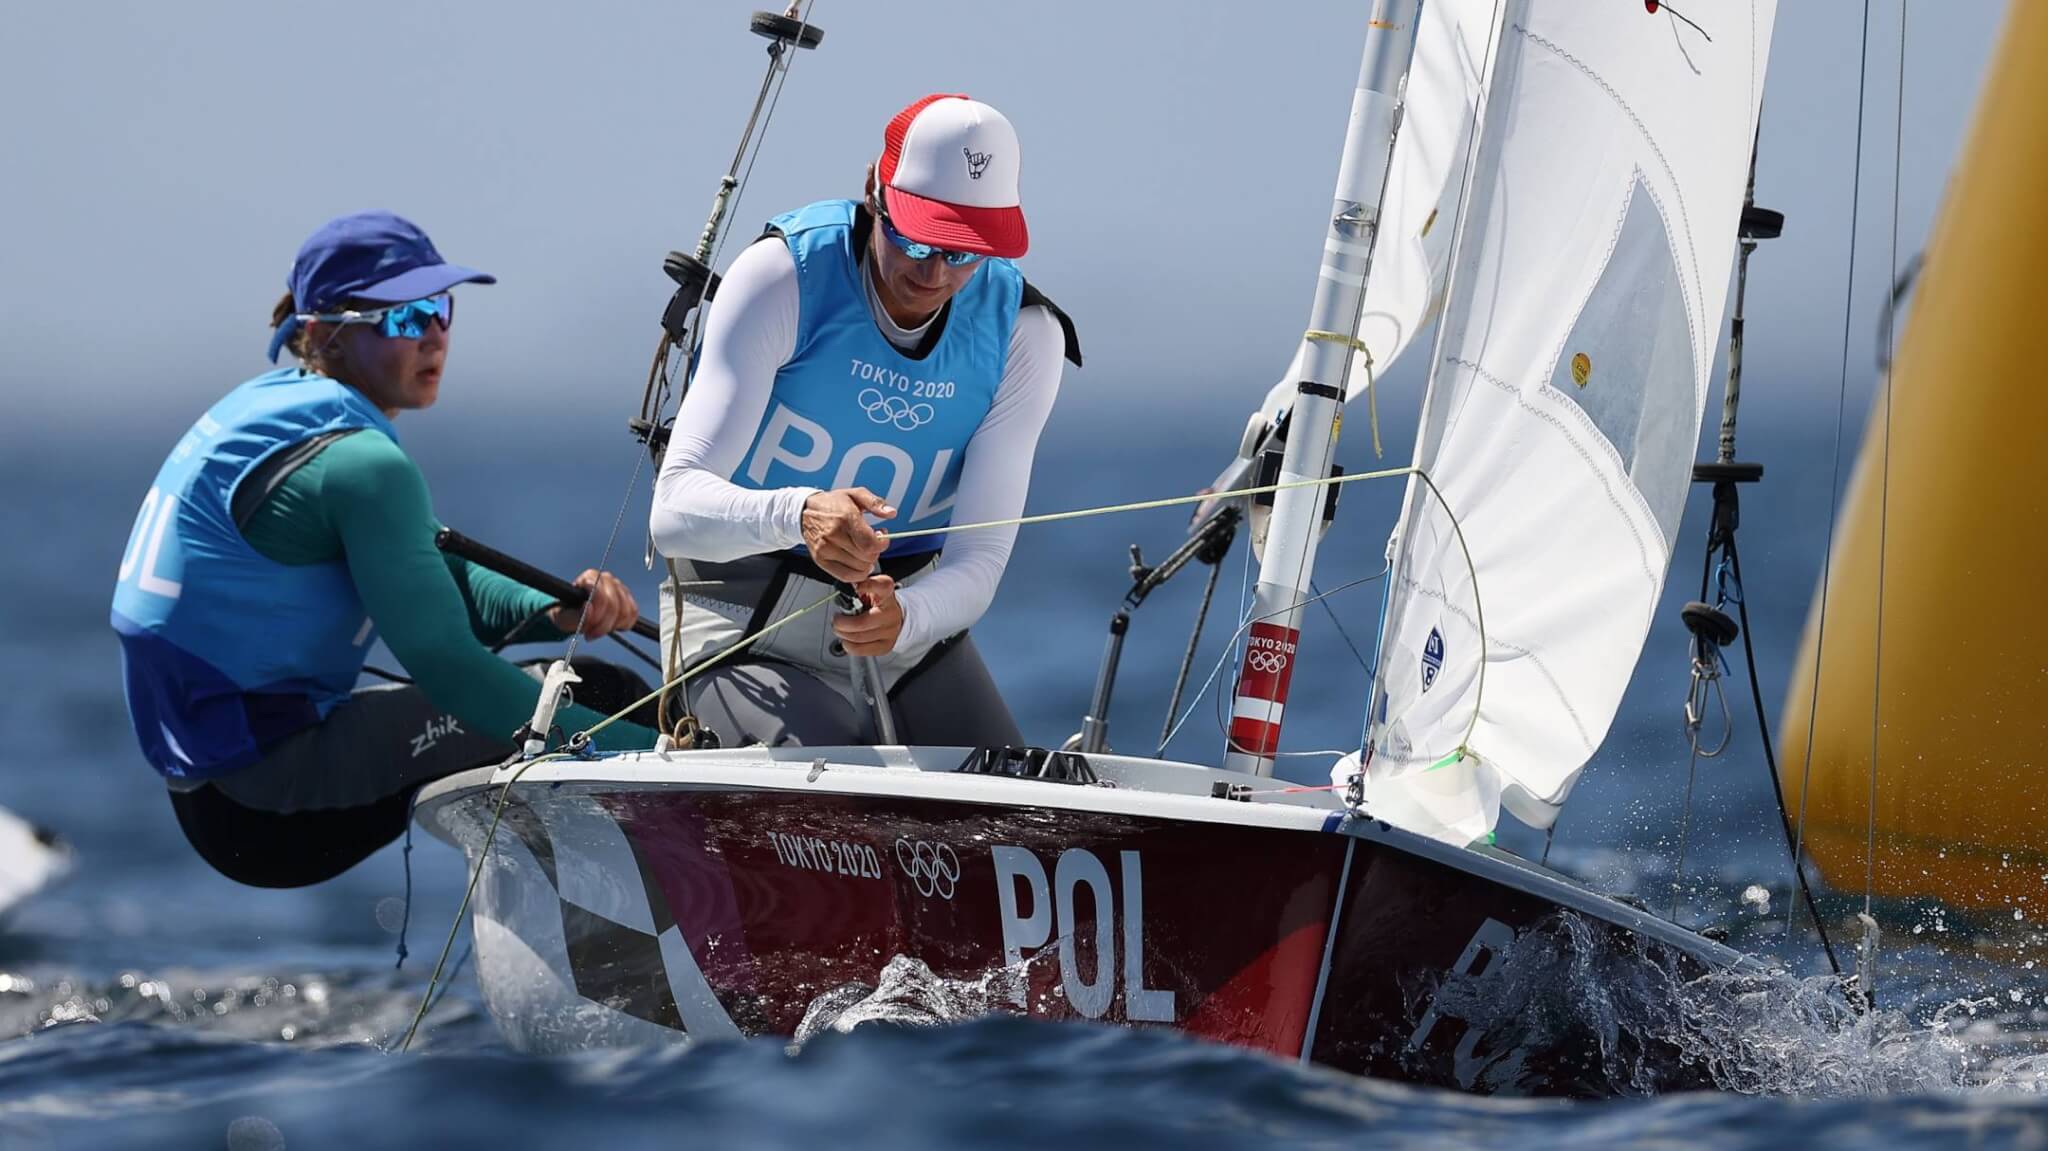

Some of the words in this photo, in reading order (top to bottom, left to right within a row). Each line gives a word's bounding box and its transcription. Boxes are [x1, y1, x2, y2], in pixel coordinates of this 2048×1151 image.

[850, 359, 910, 392] TOKYO
[912, 380, 956, 399] 2020
[746, 402, 957, 526] POL
[118, 485, 183, 599] OL
[766, 831, 833, 873] TOKYO
[830, 840, 881, 880] 2020
[991, 844, 1176, 1023] POL
